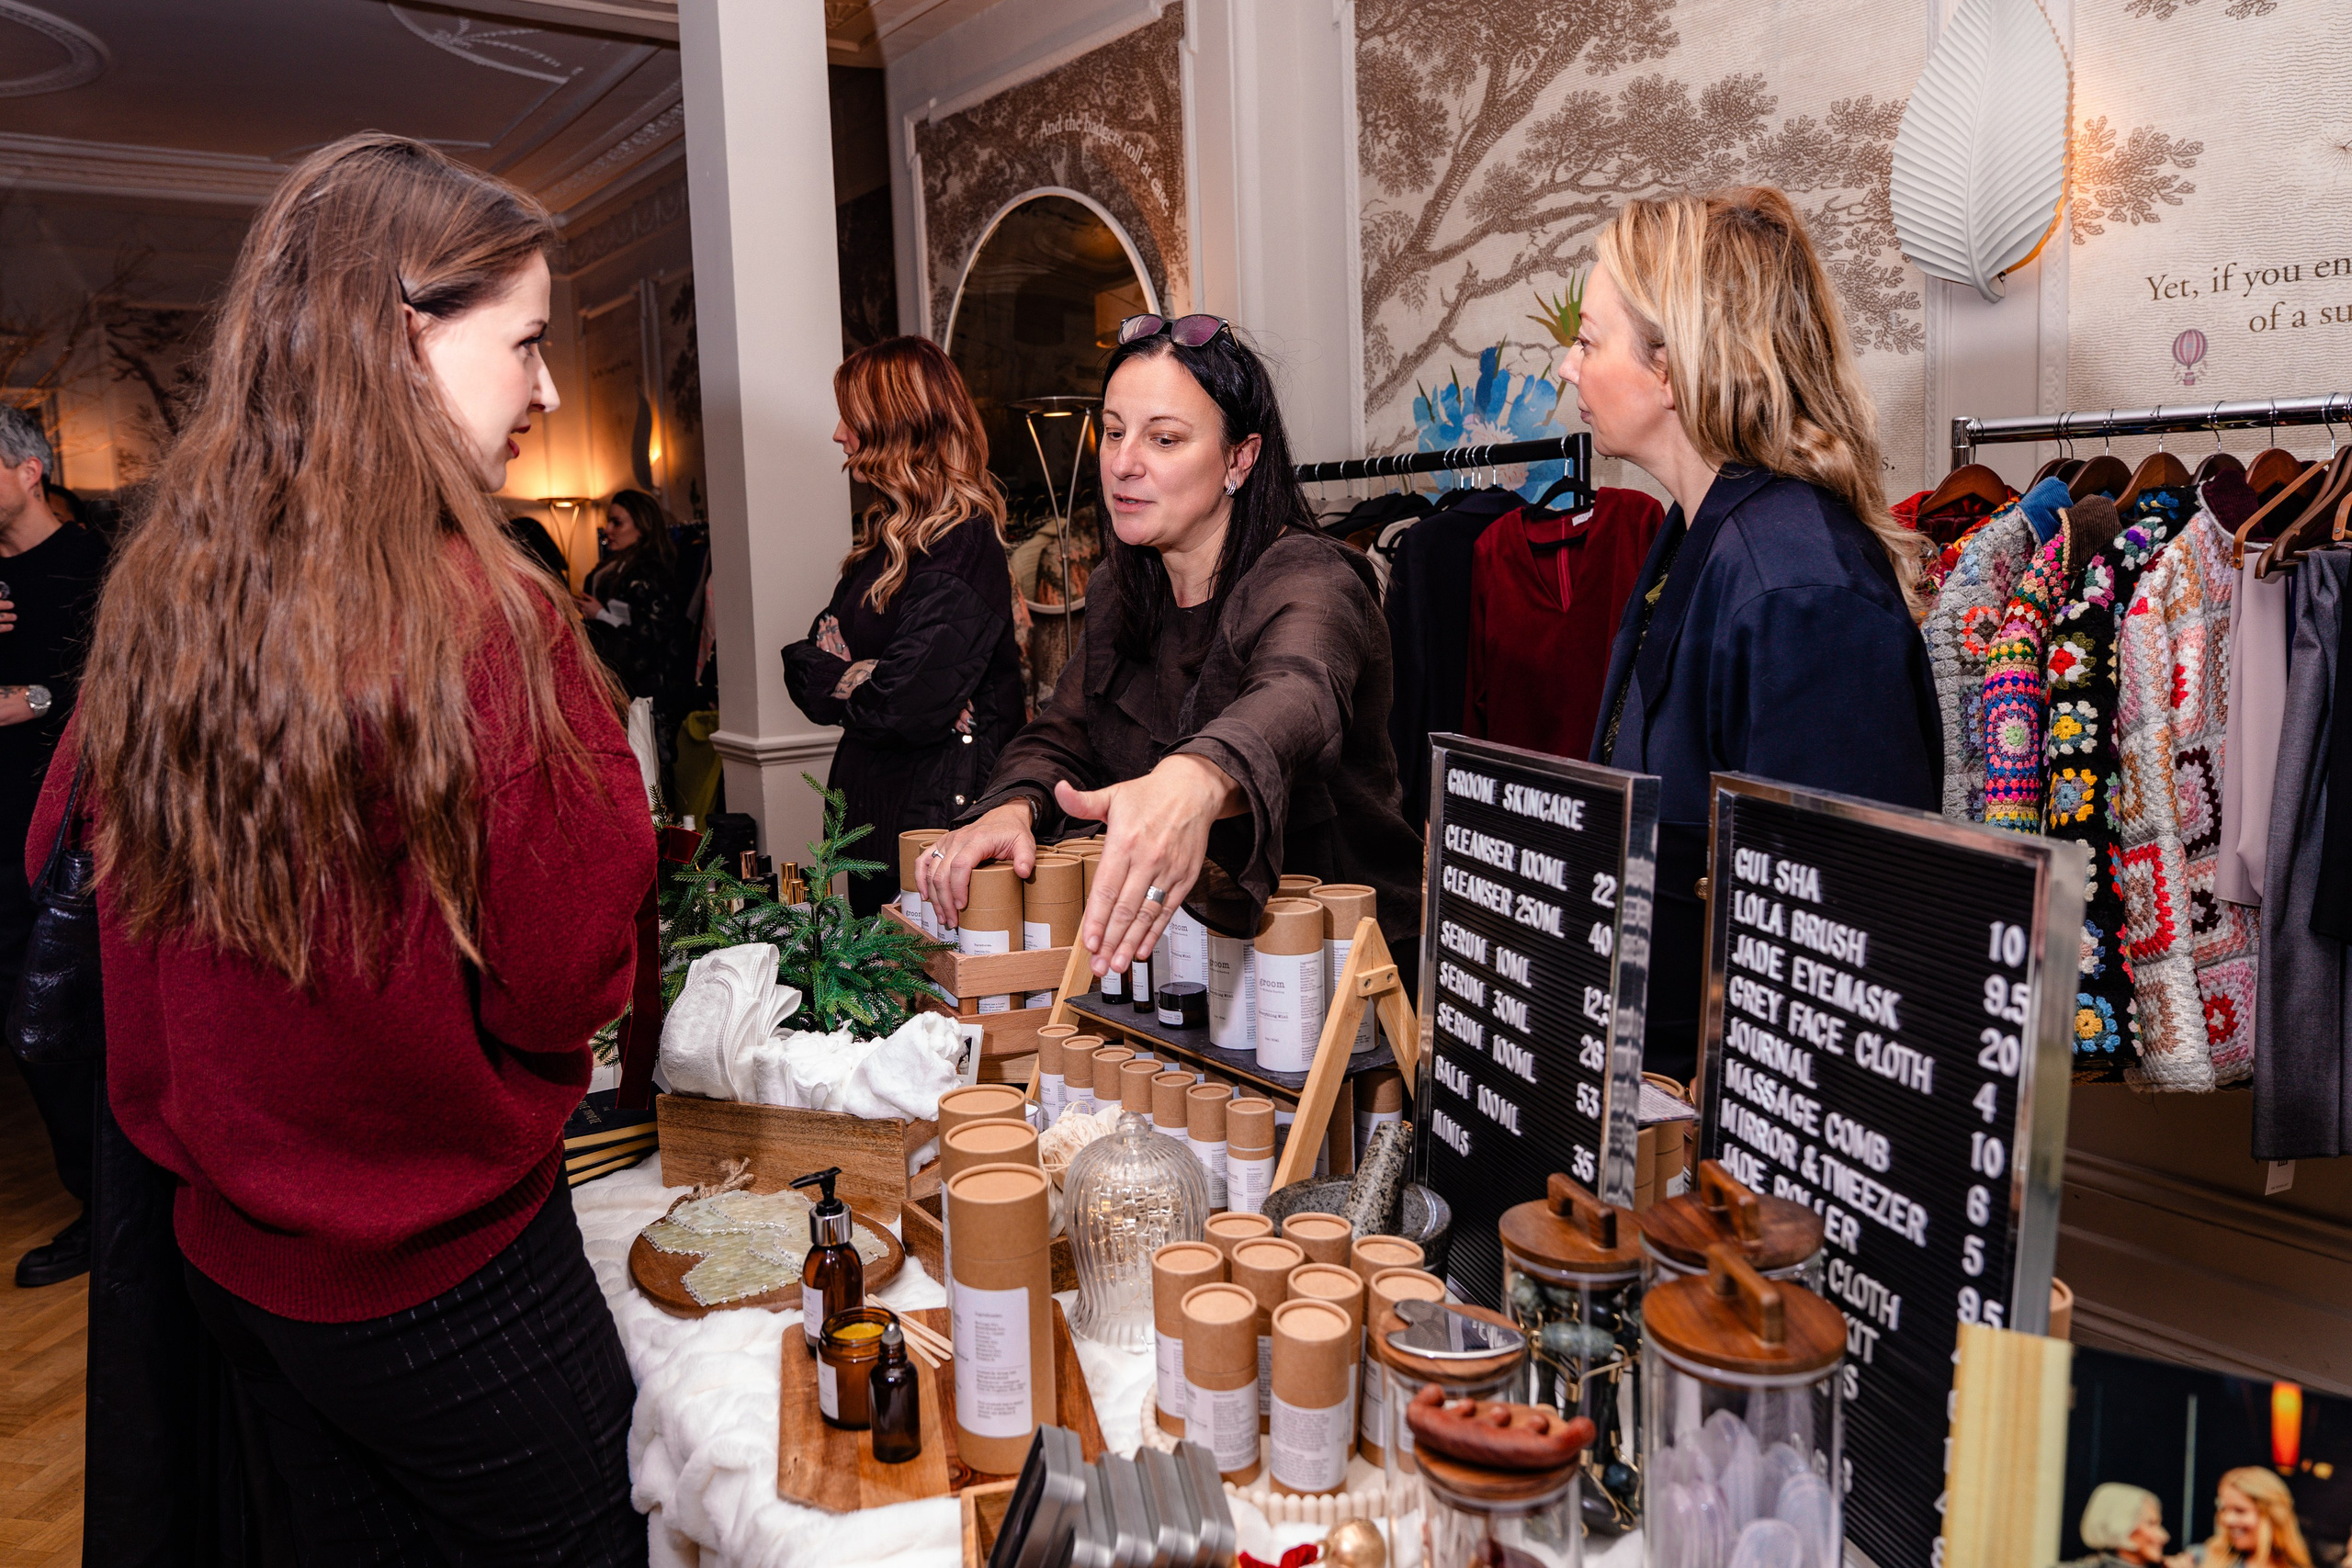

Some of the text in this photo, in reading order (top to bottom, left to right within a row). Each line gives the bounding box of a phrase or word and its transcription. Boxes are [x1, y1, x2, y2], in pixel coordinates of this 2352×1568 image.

[2145, 274, 2199, 301] Yet,
[2211, 262, 2237, 293] if
[2242, 264, 2302, 298] you
[2249, 300, 2286, 333] of
[2291, 310, 2308, 328] a
[1447, 768, 1587, 831] GROOM SKINCARE
[1442, 864, 1614, 957] CLEANSER 250ML 40
[1445, 824, 1618, 908] CLEANSER 100ML 22
[1735, 848, 2027, 968] GUI SHA 10
[1259, 977, 1285, 988] groom
[1440, 920, 1488, 965] SERUM
[1496, 946, 1532, 988] 10ML
[1735, 889, 2031, 1026] LOLA BRUSH 9.5
[1439, 961, 1606, 1073] SERUM 30ML 26
[1729, 976, 1997, 1123] GREY FACE CLOTH 4
[1731, 934, 2020, 1077] JADE EYEMASK 20
[1437, 1002, 1485, 1051] SERUM
[1492, 1034, 1537, 1084] 100ML
[1576, 1082, 1600, 1120] 53
[1726, 1016, 2005, 1179] JOURNAL 10
[1431, 1109, 1470, 1157] MINIS
[1435, 1055, 1595, 1183] BALM 100ML 35
[1718, 1143, 1768, 1194] JADE
[1725, 1058, 1822, 1137] MASSAGE
[1825, 1112, 1891, 1173] COMB
[1966, 1184, 1990, 1227] 6
[1720, 1098, 1798, 1171] MIRROR
[1962, 1234, 1985, 1277] 5
[1827, 1258, 1902, 1331] CLOTH
